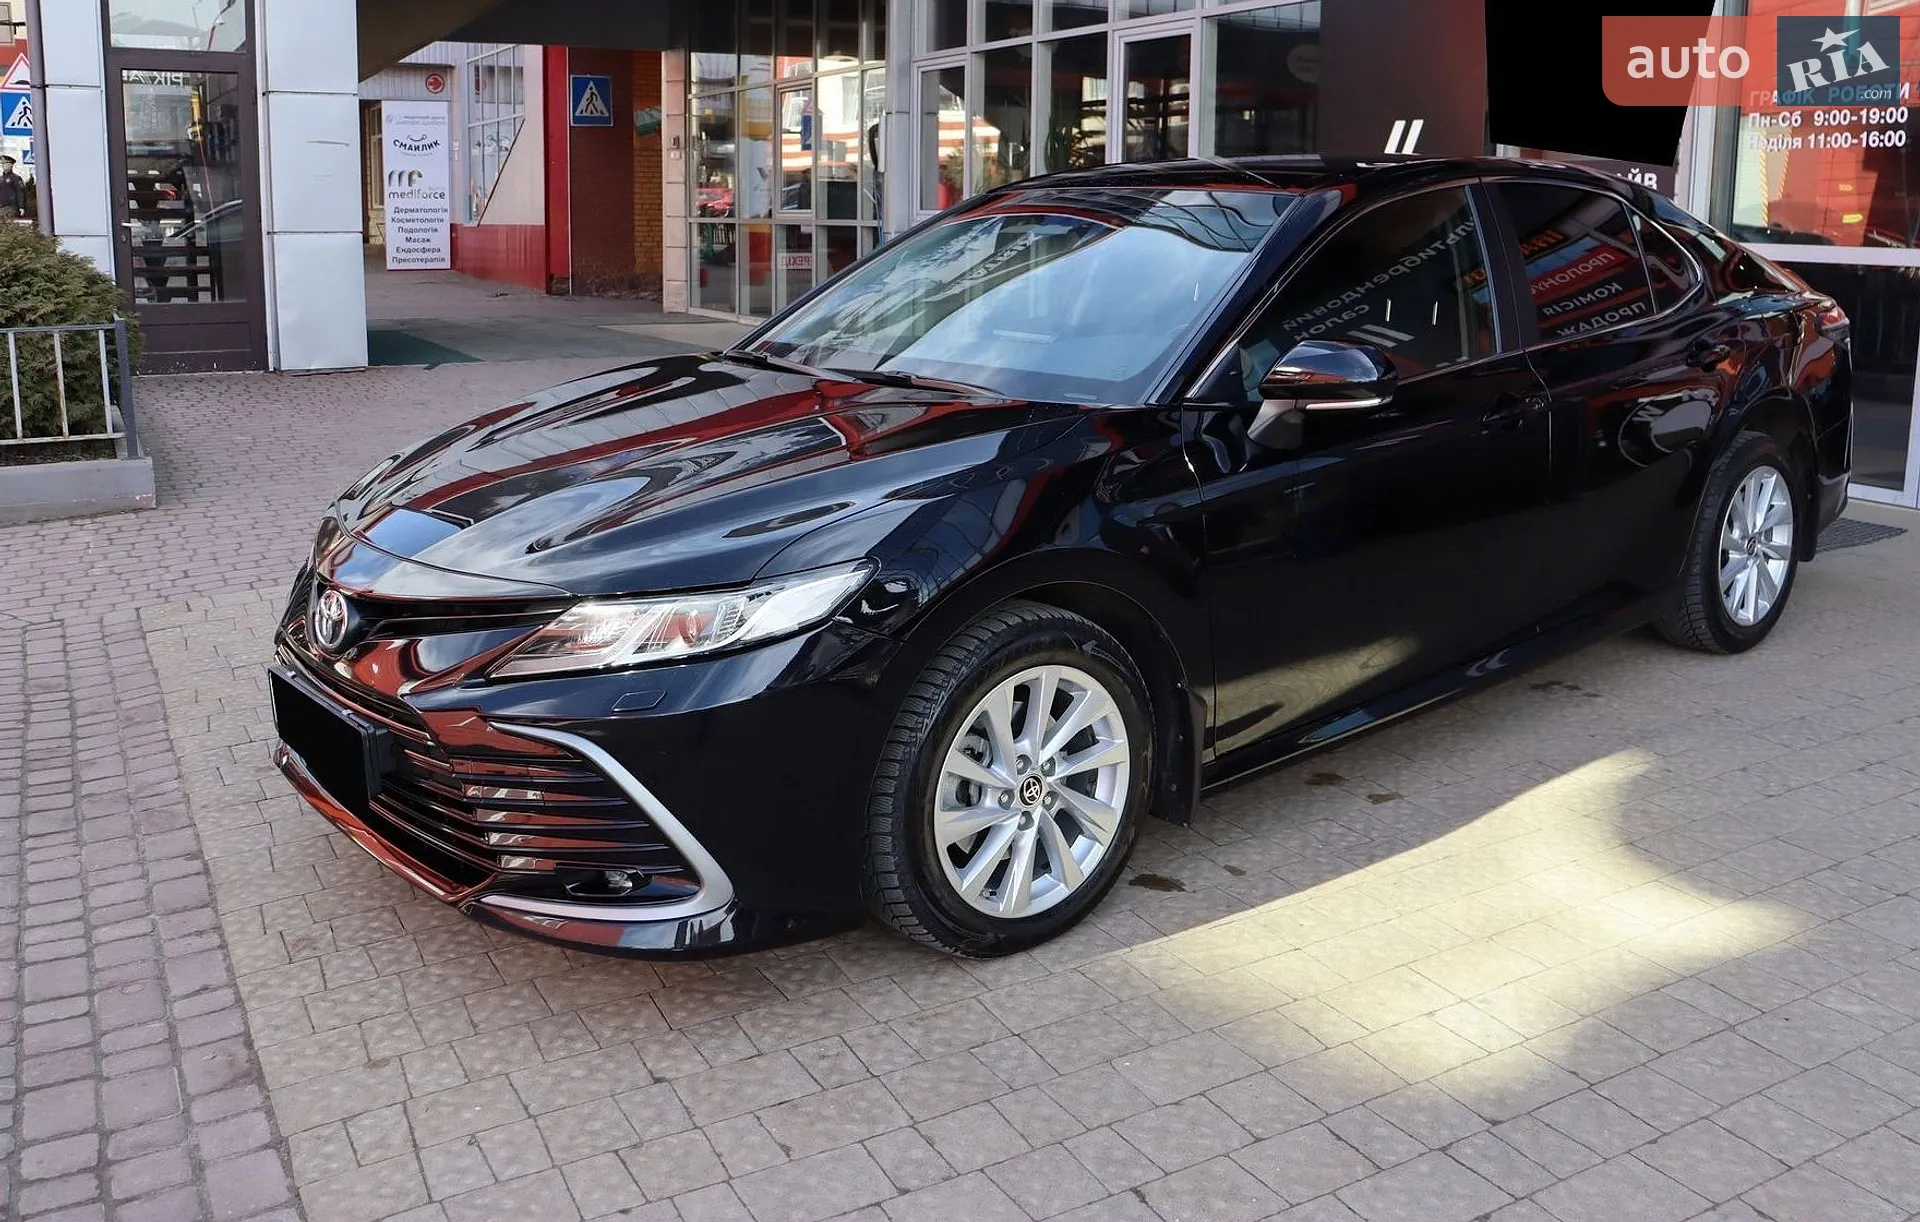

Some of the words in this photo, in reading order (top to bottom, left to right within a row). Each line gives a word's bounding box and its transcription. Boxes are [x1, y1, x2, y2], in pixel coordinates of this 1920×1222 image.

[1748, 110, 1802, 127] Пн-Сб
[1813, 106, 1908, 126] 9:00-19:00
[1747, 135, 1802, 151] Неділя
[1808, 130, 1906, 149] 11:00-16:00
[388, 188, 446, 199] mediforce
[393, 206, 448, 215] Дерматологія
[391, 216, 444, 224] Косметологія
[397, 226, 438, 234] Подологія
[391, 256, 445, 264] Пресотерапія
